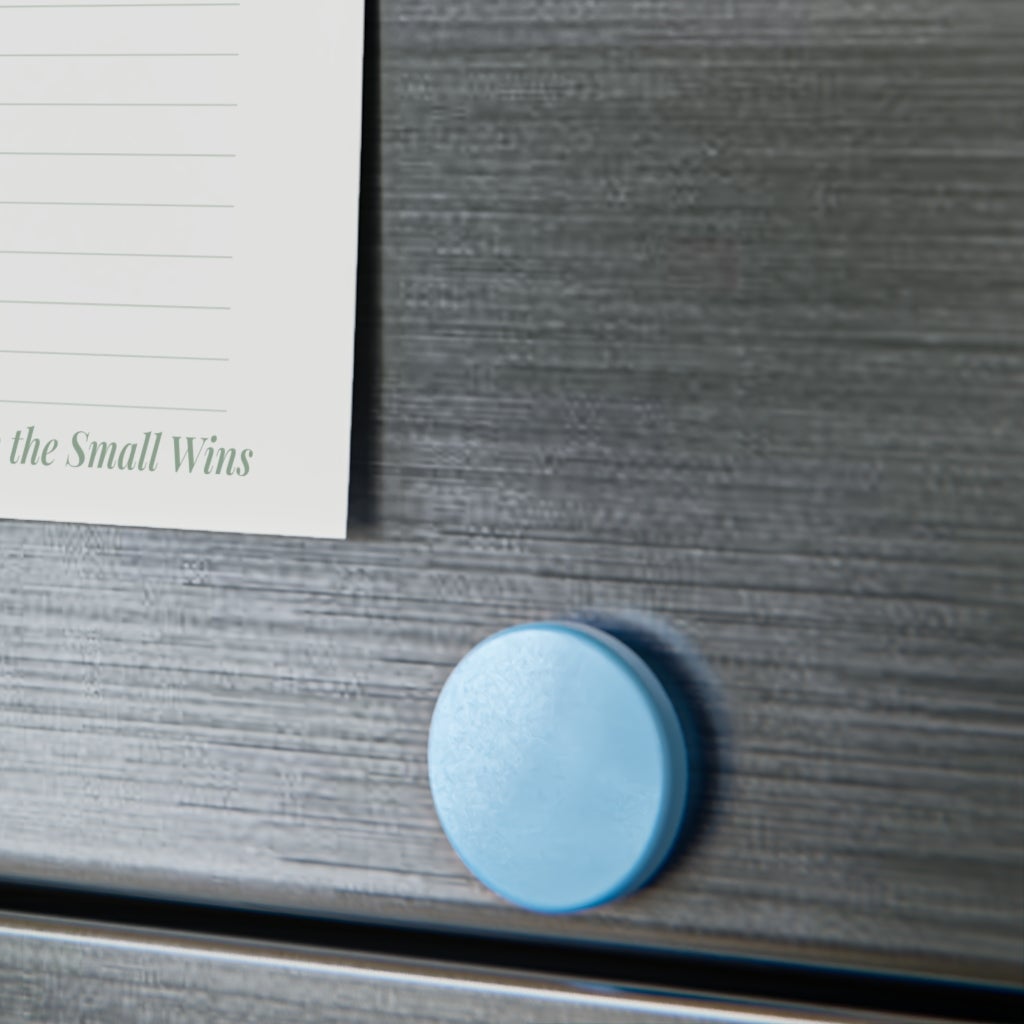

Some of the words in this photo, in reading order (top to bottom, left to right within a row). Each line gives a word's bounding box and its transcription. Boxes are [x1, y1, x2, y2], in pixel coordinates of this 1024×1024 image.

[9, 425, 59, 467] the
[65, 430, 163, 472] Small
[171, 435, 254, 477] Wins
